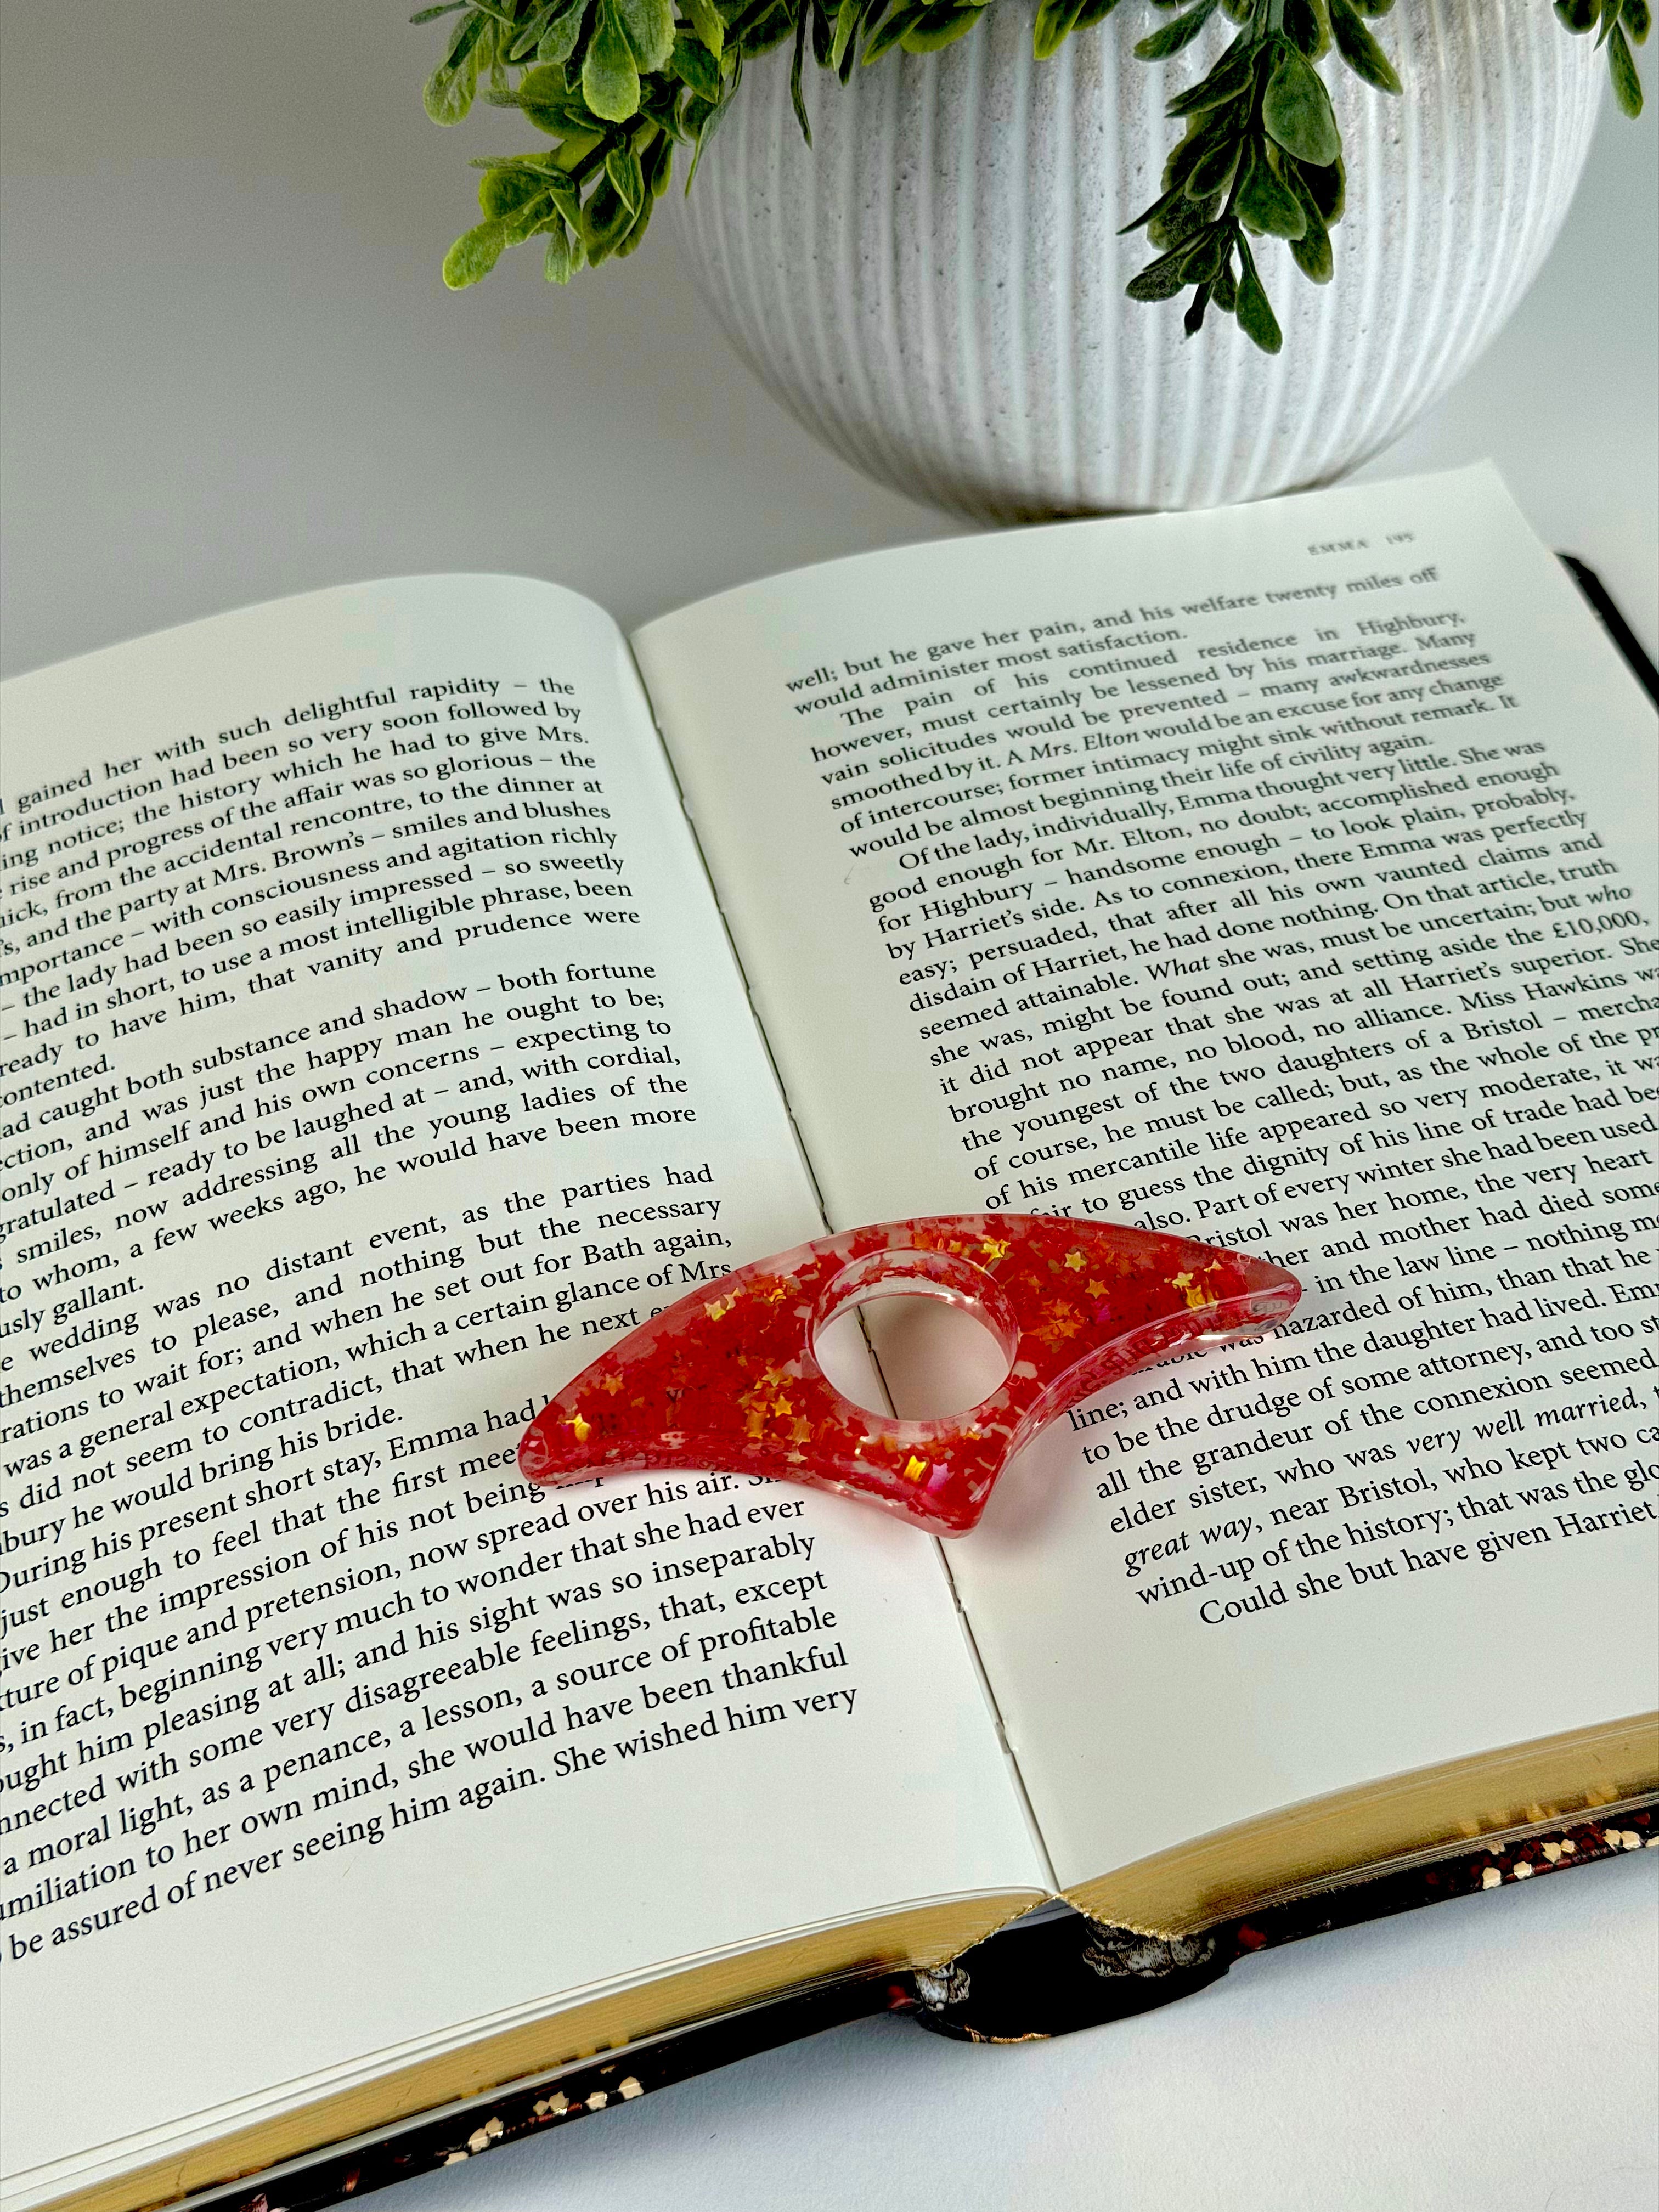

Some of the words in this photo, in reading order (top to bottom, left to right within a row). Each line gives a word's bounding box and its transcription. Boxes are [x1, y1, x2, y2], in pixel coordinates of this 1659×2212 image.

[785, 667, 838, 692] well;
[842, 656, 883, 676] but
[888, 650, 918, 665] he
[927, 639, 976, 662] gave
[981, 631, 1019, 647] her
[1028, 621, 1086, 644] pain,
[1092, 609, 1134, 629] and
[1139, 606, 1175, 622] his
[1180, 595, 1259, 615] welfare
[1265, 585, 1336, 603] twenty
[1346, 575, 1403, 592] miles
[1409, 566, 1437, 583] off
[794, 682, 865, 715] would
[870, 660, 989, 695] administer
[996, 647, 1052, 668] most
[1057, 630, 1188, 658] satisfaction.
[839, 707, 884, 726] The
[904, 691, 954, 716] pain
[974, 678, 996, 696] of
[1013, 672, 1049, 689] his
[1068, 648, 1179, 679] continued
[1197, 635, 1298, 659] residence
[1314, 629, 1339, 642] in
[1356, 612, 1465, 636] Highbury,
[47, 820, 125, 855] notice;
[133, 804, 170, 825] the
[178, 777, 261, 811] history
[270, 753, 344, 783] which
[351, 747, 382, 764] he
[390, 732, 437, 757] had
[445, 733, 470, 747] to
[480, 727, 527, 748] give
[536, 726, 589, 744] Mrs.
[899, 847, 930, 870] Of
[933, 842, 972, 861] the
[972, 828, 1030, 851] lady,
[1032, 800, 1175, 838] individually,
[1175, 789, 1253, 811] Emma
[1255, 771, 1346, 798] thought
[1346, 765, 1395, 782] very
[1397, 754, 1458, 774] little.
[1458, 747, 1500, 764] She
[1503, 742, 1545, 757] was
[899, 960, 957, 985] easy;
[967, 920, 1098, 971] persuaded,
[1107, 911, 1156, 932] that
[1166, 900, 1218, 921] after
[1230, 888, 1260, 909] all
[1266, 884, 1305, 902] his
[1315, 876, 1366, 894] own
[1374, 854, 1468, 883] vaunted
[1478, 845, 1550, 867] claims
[1559, 832, 1604, 854] and
[75, 1032, 99, 1050] to
[110, 1009, 167, 1039] have
[178, 990, 236, 1017] him,
[247, 967, 297, 994] that
[307, 946, 384, 976] vanity
[397, 927, 444, 953] and
[455, 913, 572, 947] prudence
[583, 911, 641, 924] were
[930, 1045, 970, 1067] she
[978, 1029, 1033, 1051] was,
[1041, 1005, 1115, 1035] might
[1119, 998, 1153, 1015] be
[1161, 977, 1235, 1008] found
[1243, 972, 1290, 991] out;
[1297, 957, 1345, 981] and
[1352, 948, 1434, 972] setting
[1438, 934, 1499, 957] aside
[1505, 928, 1544, 946] the
[1552, 910, 1650, 939] £10,000,
[1278, 1212, 1328, 1233] was
[1332, 1201, 1379, 1221] her
[1383, 1186, 1469, 1211] home,
[1474, 1173, 1516, 1194] the
[1521, 1164, 1576, 1184] very
[1582, 1149, 1654, 1174] heart
[151, 1335, 177, 1355] to
[193, 1303, 279, 1348] please,
[295, 1273, 345, 1307] and
[359, 1246, 465, 1288] nothing
[476, 1228, 524, 1254] but
[538, 1217, 582, 1240] the
[596, 1200, 721, 1229] necessary
[3, 1449, 52, 1477] was
[58, 1443, 74, 1459] a
[80, 1399, 175, 1459] general
[180, 1355, 340, 1416] expectation,
[345, 1321, 428, 1361] which
[433, 1321, 449, 1336] a
[455, 1294, 549, 1330] certain
[555, 1277, 640, 1312] glance
[647, 1263, 674, 1288] of
[1081, 1444, 1110, 1464] to
[1112, 1431, 1150, 1453] be
[1155, 1416, 1200, 1441] the
[1207, 1392, 1302, 1427] drudge
[1308, 1376, 1336, 1402] of
[1341, 1367, 1412, 1395] some
[1417, 1343, 1532, 1378] attorney,
[1536, 1325, 1588, 1353] and
[1589, 1323, 1635, 1342] too
[0, 1597, 50, 1640] just
[61, 1556, 163, 1609] enough
[173, 1548, 201, 1570] to
[212, 1519, 262, 1558] feel
[271, 1502, 327, 1536] that
[336, 1487, 381, 1514] the
[392, 1464, 448, 1498] first
[1125, 1531, 1190, 1577] great
[1199, 1516, 1263, 1545] way,
[1268, 1497, 1330, 1526] near
[1335, 1467, 1438, 1509] Bristol,
[1442, 1457, 1503, 1483] who
[1505, 1441, 1572, 1471] kept
[1575, 1434, 1627, 1456] two
[1200, 1579, 1290, 1624] Could
[1296, 1572, 1343, 1599] she
[1344, 1557, 1399, 1584] but
[1399, 1544, 1469, 1572] have
[1476, 1527, 1552, 1562] given
[1553, 1500, 1658, 1538] Harriet
[3, 1857, 20, 1876] a
[27, 1814, 112, 1869] moral
[118, 1793, 193, 1836] light,
[202, 1781, 230, 1805] as
[239, 1774, 256, 1792] a
[263, 1730, 391, 1793] penance,
[399, 1720, 416, 1738] a
[421, 1689, 522, 1731] lesson,
[531, 1680, 549, 1697] a
[556, 1651, 652, 1690] source
[661, 1632, 691, 1662] of
[697, 1606, 837, 1662] profitable
[8, 1933, 44, 1960] be
[51, 1884, 160, 1946] assured
[167, 1870, 199, 1904] of
[204, 1849, 283, 1893] never
[292, 1815, 385, 1862] seeing
[388, 1795, 452, 1829] him
[458, 1767, 546, 1809] again.
[553, 1746, 607, 1777] She
[612, 1709, 720, 1759] wished
[723, 1703, 788, 1732] him
[792, 1688, 857, 1716] very
